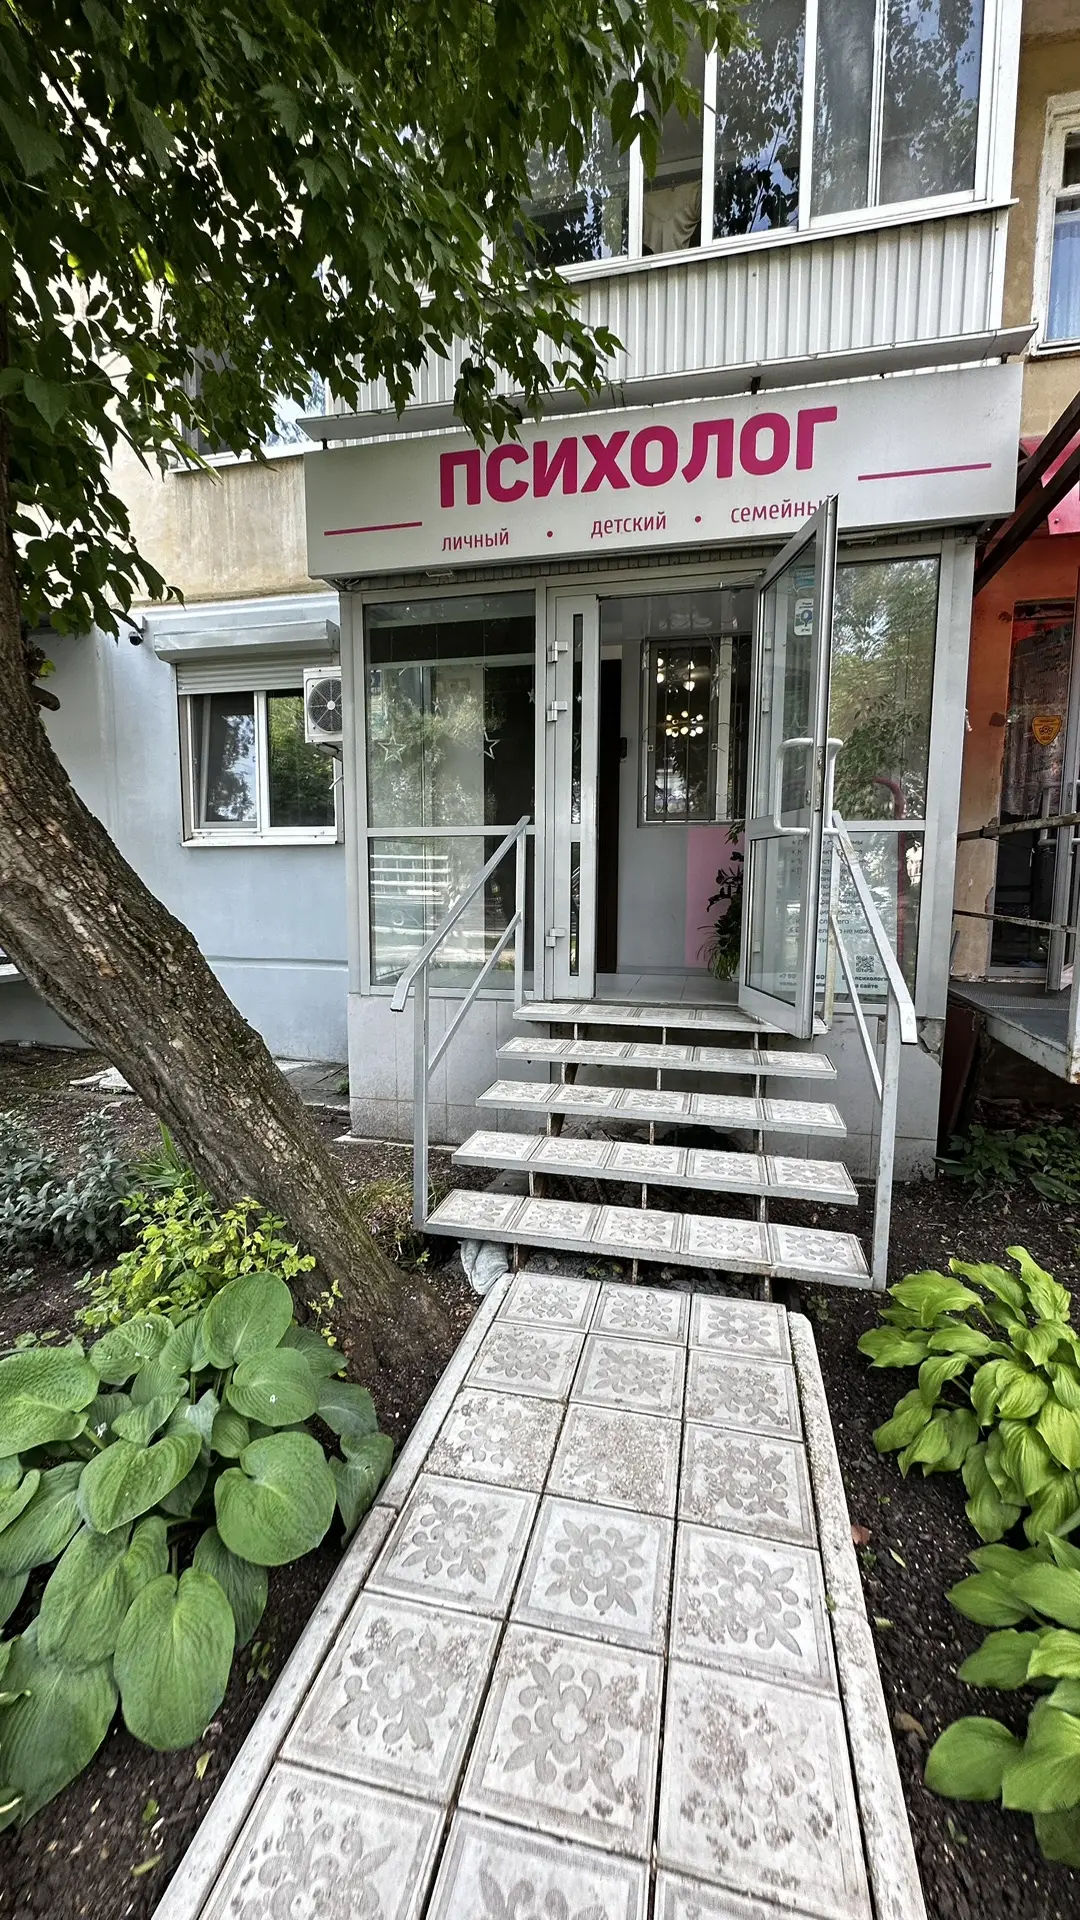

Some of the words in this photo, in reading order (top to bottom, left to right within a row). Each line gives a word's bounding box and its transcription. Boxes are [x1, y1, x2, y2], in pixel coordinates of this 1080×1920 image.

[441, 527, 510, 552] личный
[590, 511, 667, 539] детский
[730, 494, 834, 524] семейны
